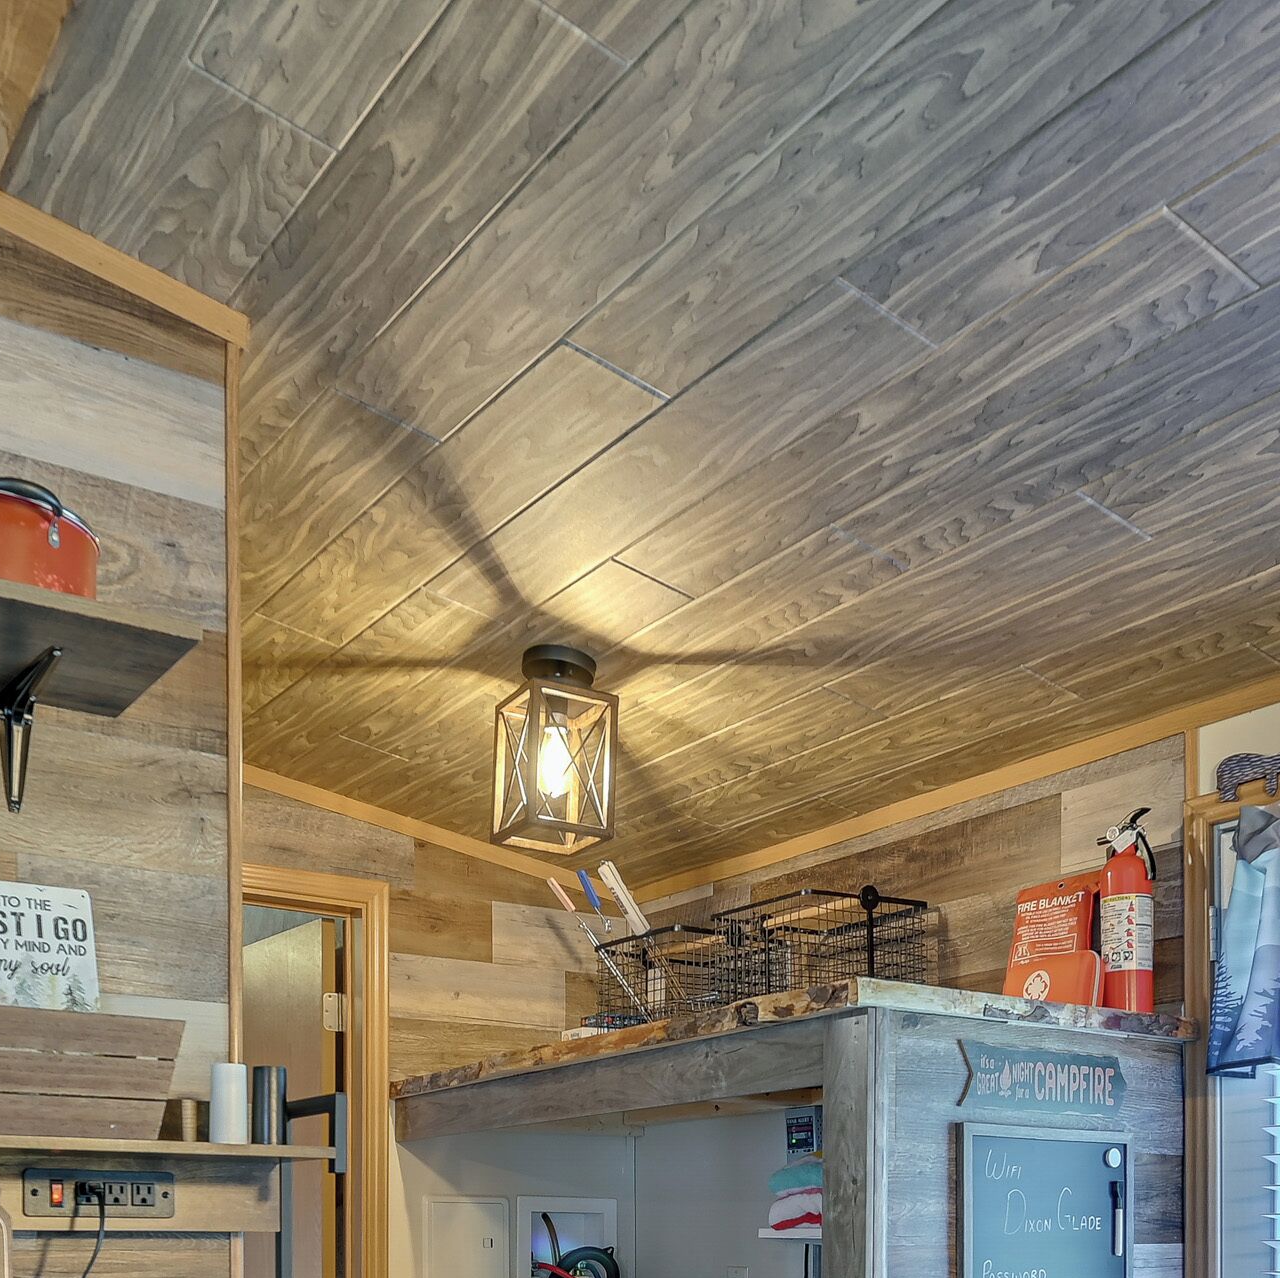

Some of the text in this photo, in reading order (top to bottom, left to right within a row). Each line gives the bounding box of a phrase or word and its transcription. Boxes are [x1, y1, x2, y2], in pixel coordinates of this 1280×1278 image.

[25, 897, 52, 911] THE
[1017, 891, 1085, 915] FIRE BLANKET
[36, 915, 44, 938] I
[53, 916, 88, 942] GO
[14, 939, 51, 954] MIND
[56, 942, 87, 957] AND
[31, 956, 71, 977] soul
[976, 1072, 1000, 1095] GREAT
[1012, 1061, 1035, 1084] NIGHT
[1034, 1061, 1115, 1106] CAMPFIRE
